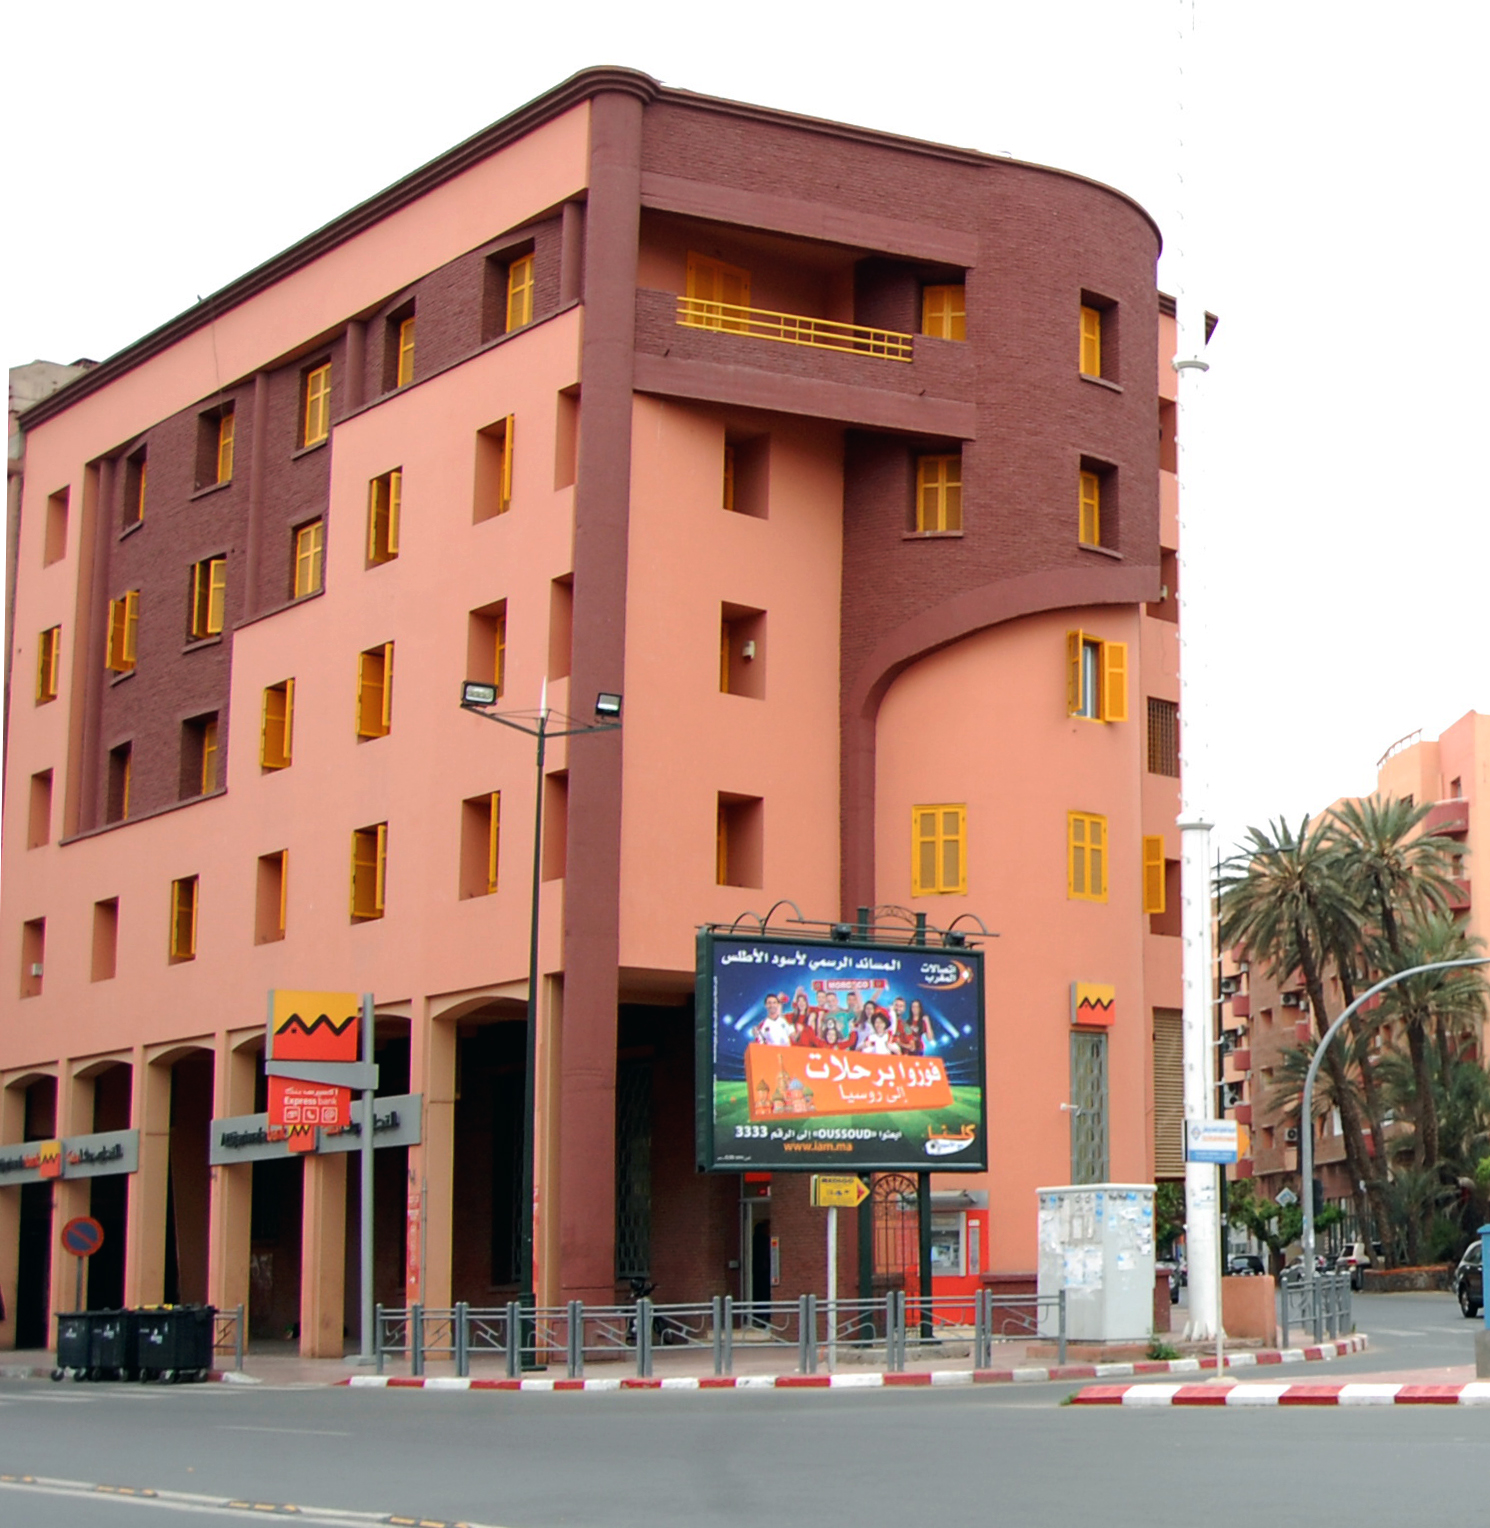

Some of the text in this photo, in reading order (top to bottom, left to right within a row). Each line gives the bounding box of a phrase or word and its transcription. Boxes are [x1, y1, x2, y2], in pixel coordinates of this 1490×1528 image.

[720, 948, 901, 971] المساند الرسمي لأسود الأطلس
[805, 1052, 943, 1088] فوزوا برحلات
[284, 1095, 338, 1107] Express bank
[838, 1083, 909, 1104] إلى روسيا
[734, 1125, 768, 1138] 3333
[927, 1123, 976, 1140] كلنا
[783, 1142, 853, 1152] www.iam.ma
